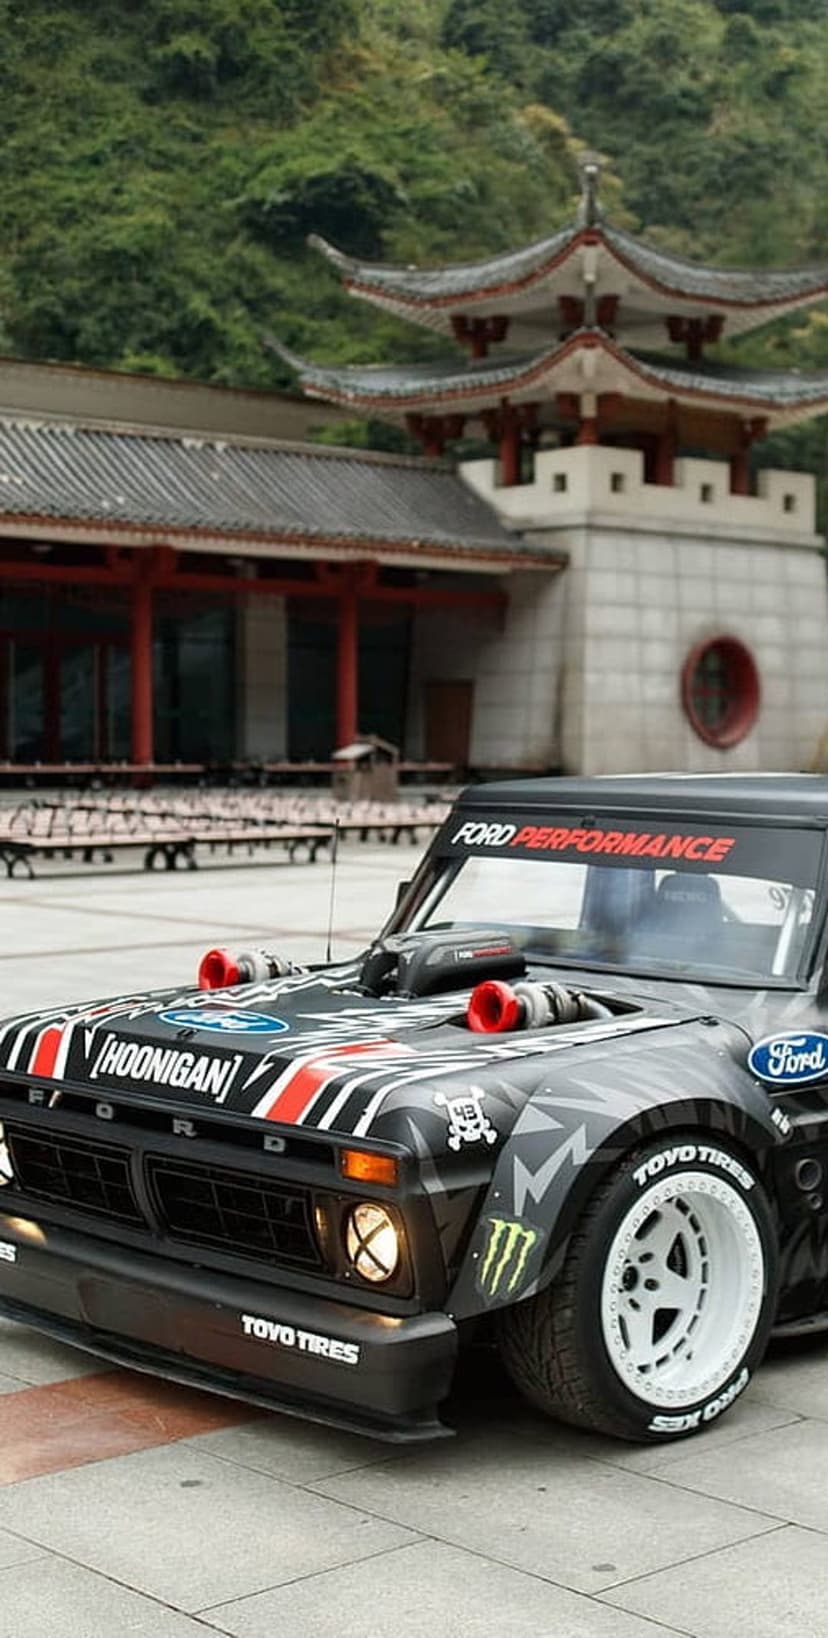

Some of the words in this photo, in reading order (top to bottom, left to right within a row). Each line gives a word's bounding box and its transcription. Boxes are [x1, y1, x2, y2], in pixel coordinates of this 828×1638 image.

[451, 822, 517, 847] FORD
[509, 826, 737, 861] PERFORMANCE
[767, 1038, 826, 1076] Ford
[453, 1104, 478, 1121] 43
[632, 1145, 697, 1186] TOYO
[698, 1146, 756, 1190] TIRES
[241, 1314, 295, 1346] TOYO
[297, 1329, 360, 1365] TIRES
